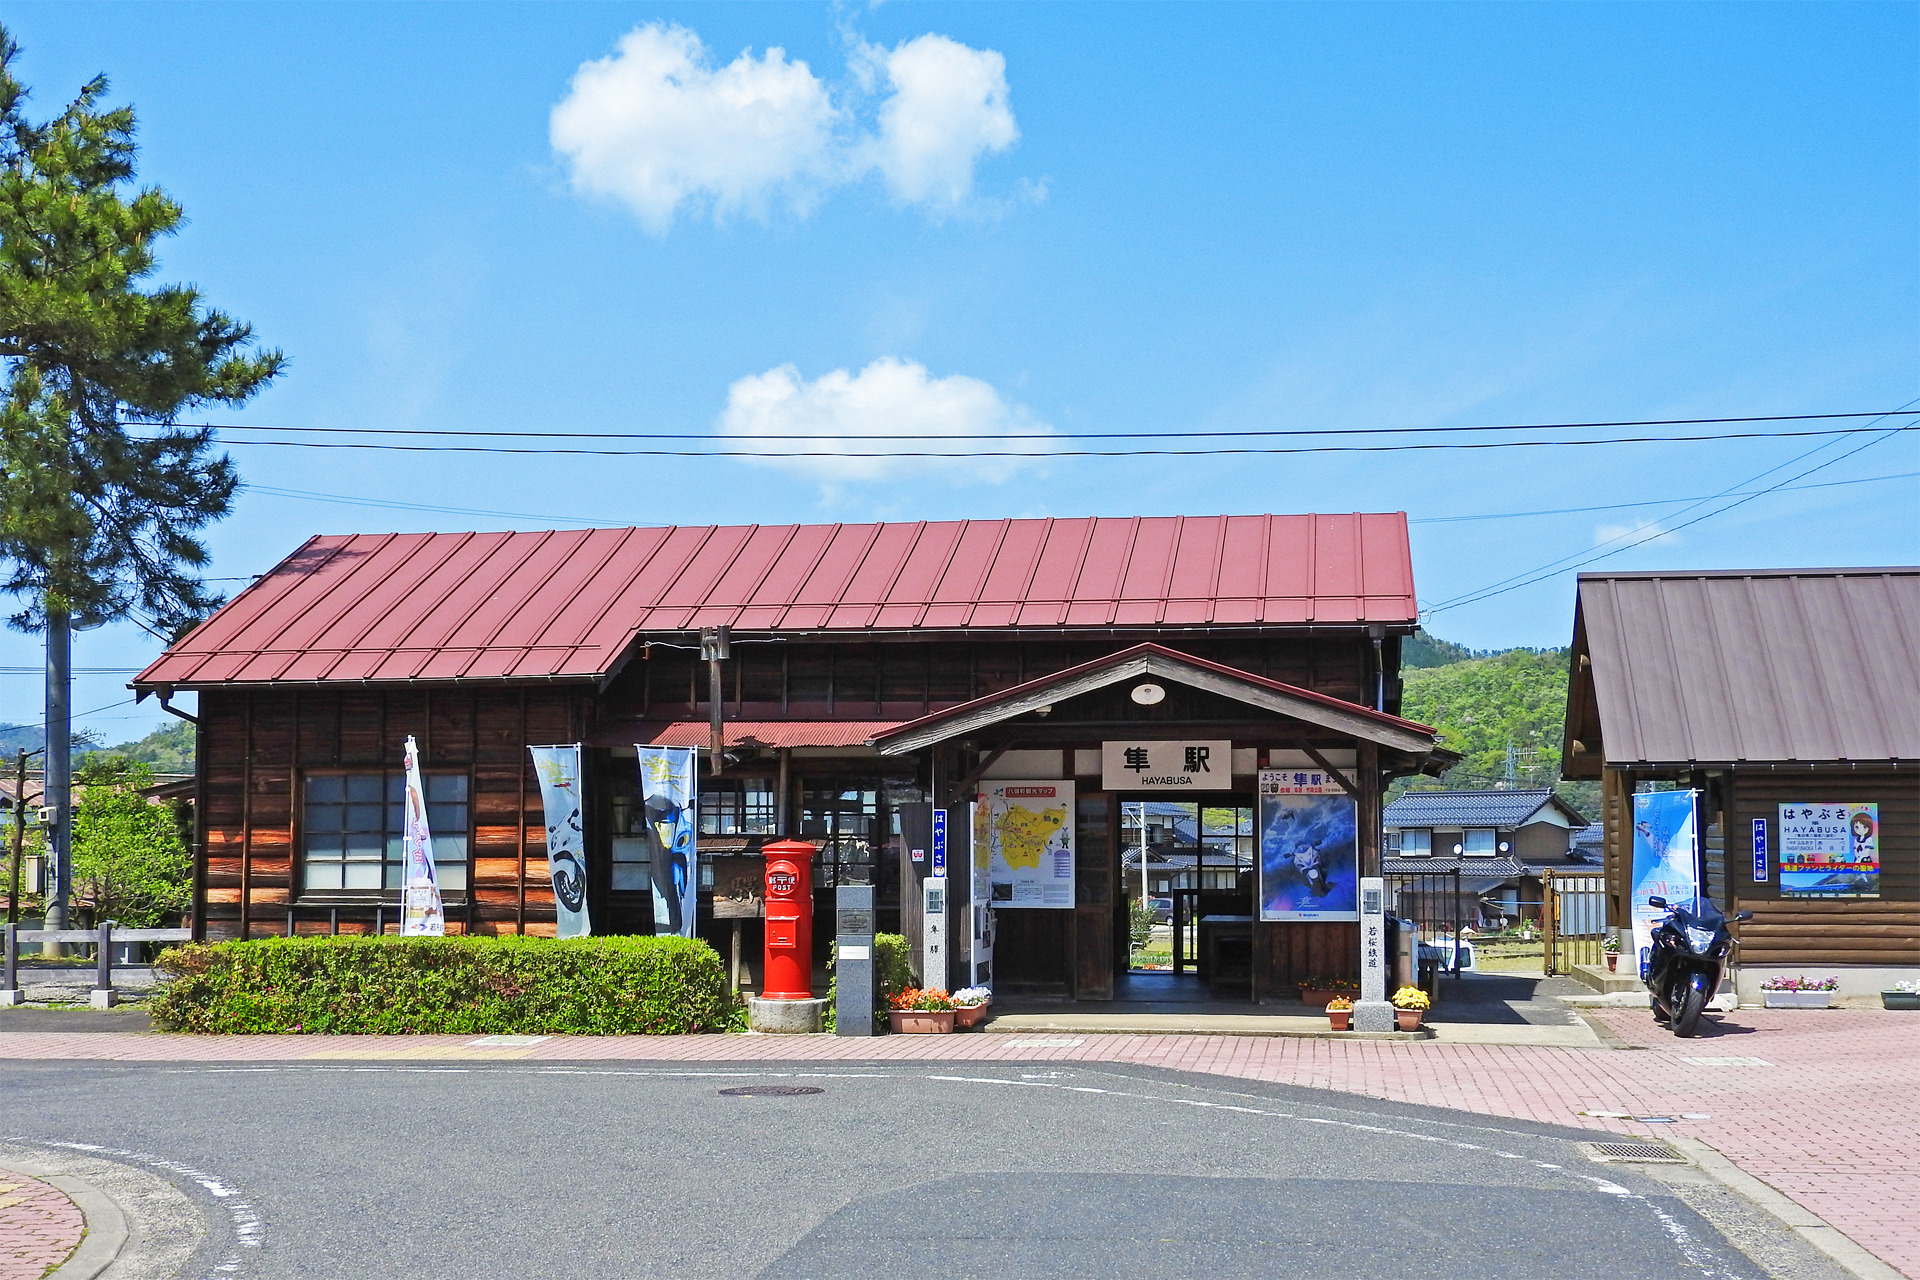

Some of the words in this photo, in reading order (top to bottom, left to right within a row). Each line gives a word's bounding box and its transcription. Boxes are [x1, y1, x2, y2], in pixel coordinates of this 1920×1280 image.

[1123, 746, 1211, 774] 隼駅
[1141, 776, 1192, 786] HAYABUSA
[1261, 773, 1288, 781] ようこそ
[1293, 772, 1322, 787] 隼駅
[1783, 808, 1846, 820] はやぶさ
[935, 814, 944, 864] はやぶさ
[1755, 823, 1764, 867] はやぶさ
